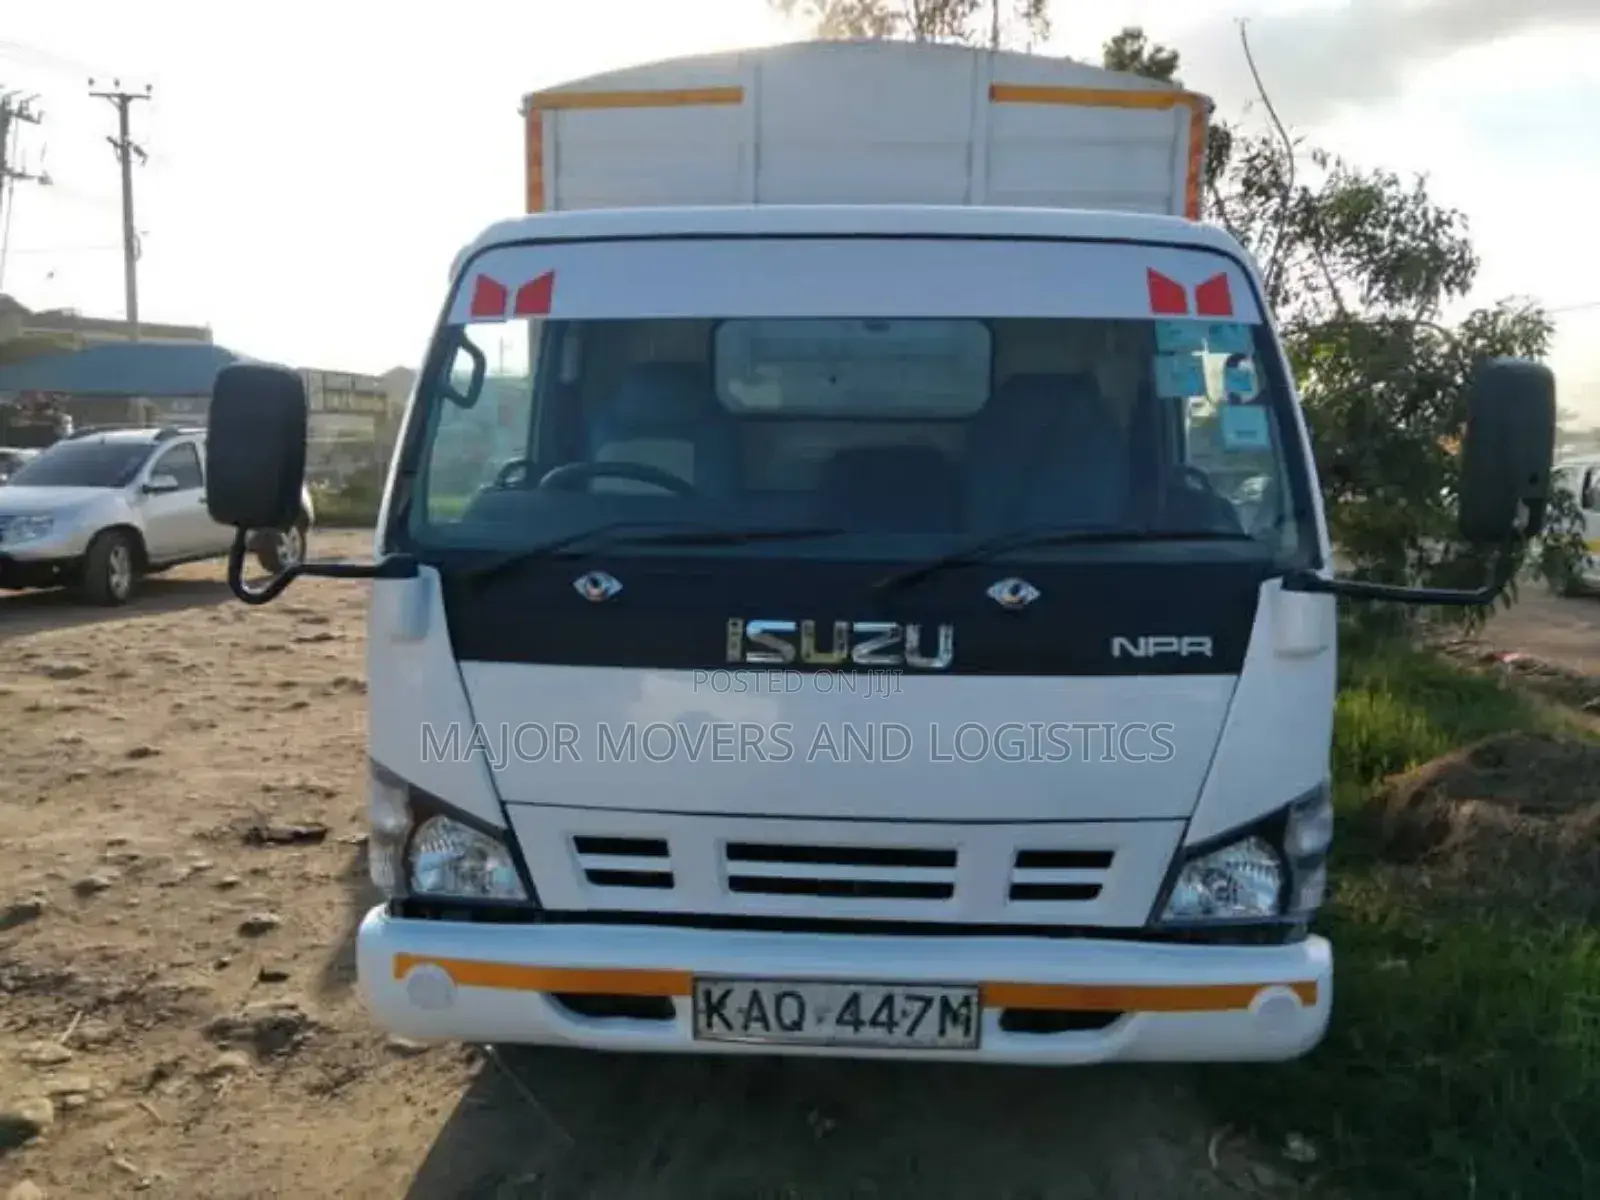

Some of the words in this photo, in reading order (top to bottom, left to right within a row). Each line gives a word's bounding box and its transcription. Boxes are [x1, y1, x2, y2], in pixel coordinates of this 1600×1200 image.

[725, 617, 956, 669] ISUZU
[1111, 635, 1213, 659] NPR
[703, 987, 806, 1032] KAQ
[835, 992, 972, 1038] 447M
